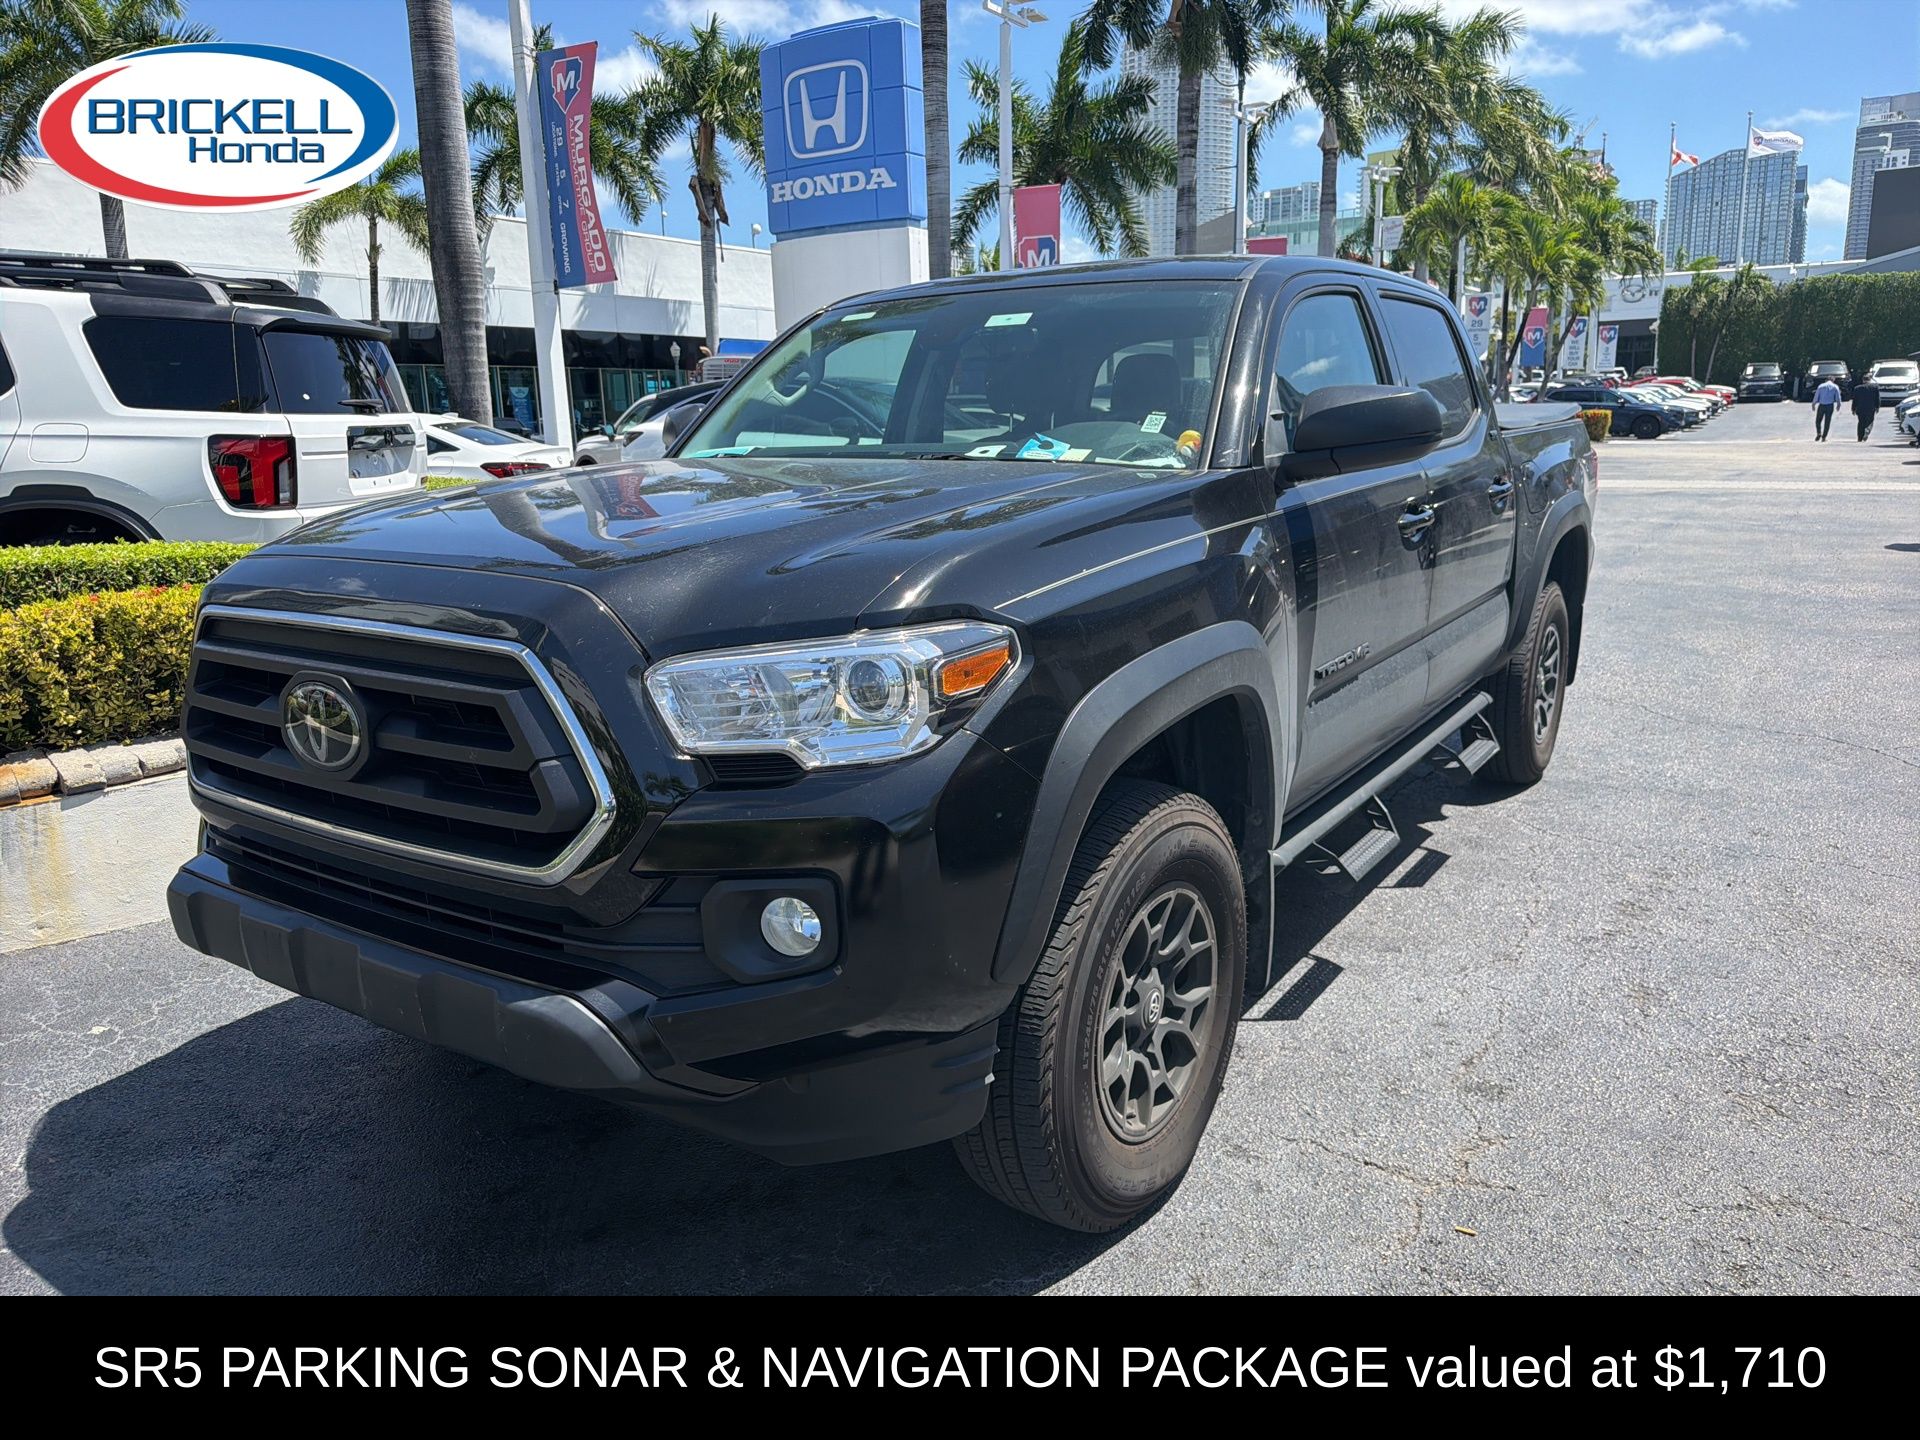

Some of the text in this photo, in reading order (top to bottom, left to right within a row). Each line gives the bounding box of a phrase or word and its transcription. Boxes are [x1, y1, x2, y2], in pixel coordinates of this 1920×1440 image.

[556, 71, 575, 93] M
[568, 118, 596, 274] AUTOMOTIVE GROUP
[573, 114, 606, 273] MURGADO
[771, 167, 896, 204] HONDA
[562, 199, 570, 209] 7
[1527, 331, 1541, 341] M
